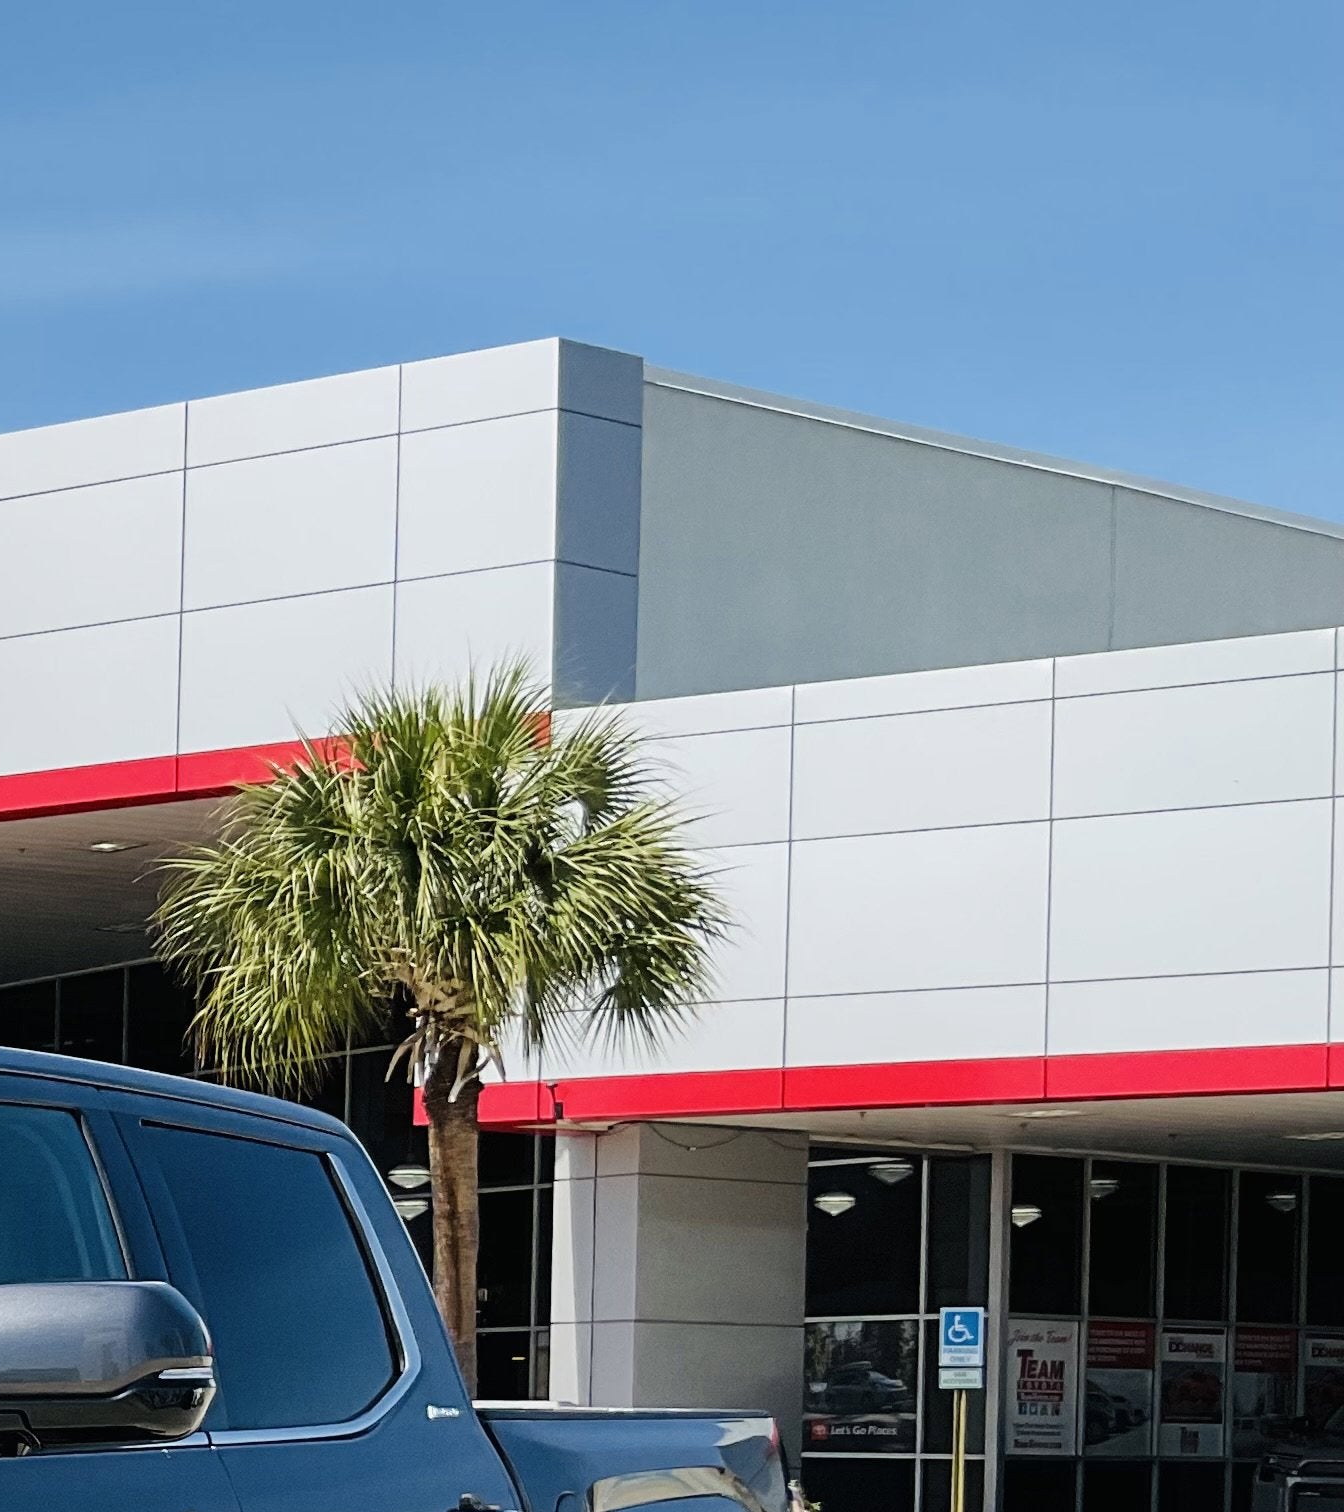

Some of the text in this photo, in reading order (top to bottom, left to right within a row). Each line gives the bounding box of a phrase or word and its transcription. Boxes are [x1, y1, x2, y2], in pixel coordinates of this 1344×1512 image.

[830, 1424, 898, 1436] Let's Go Places
